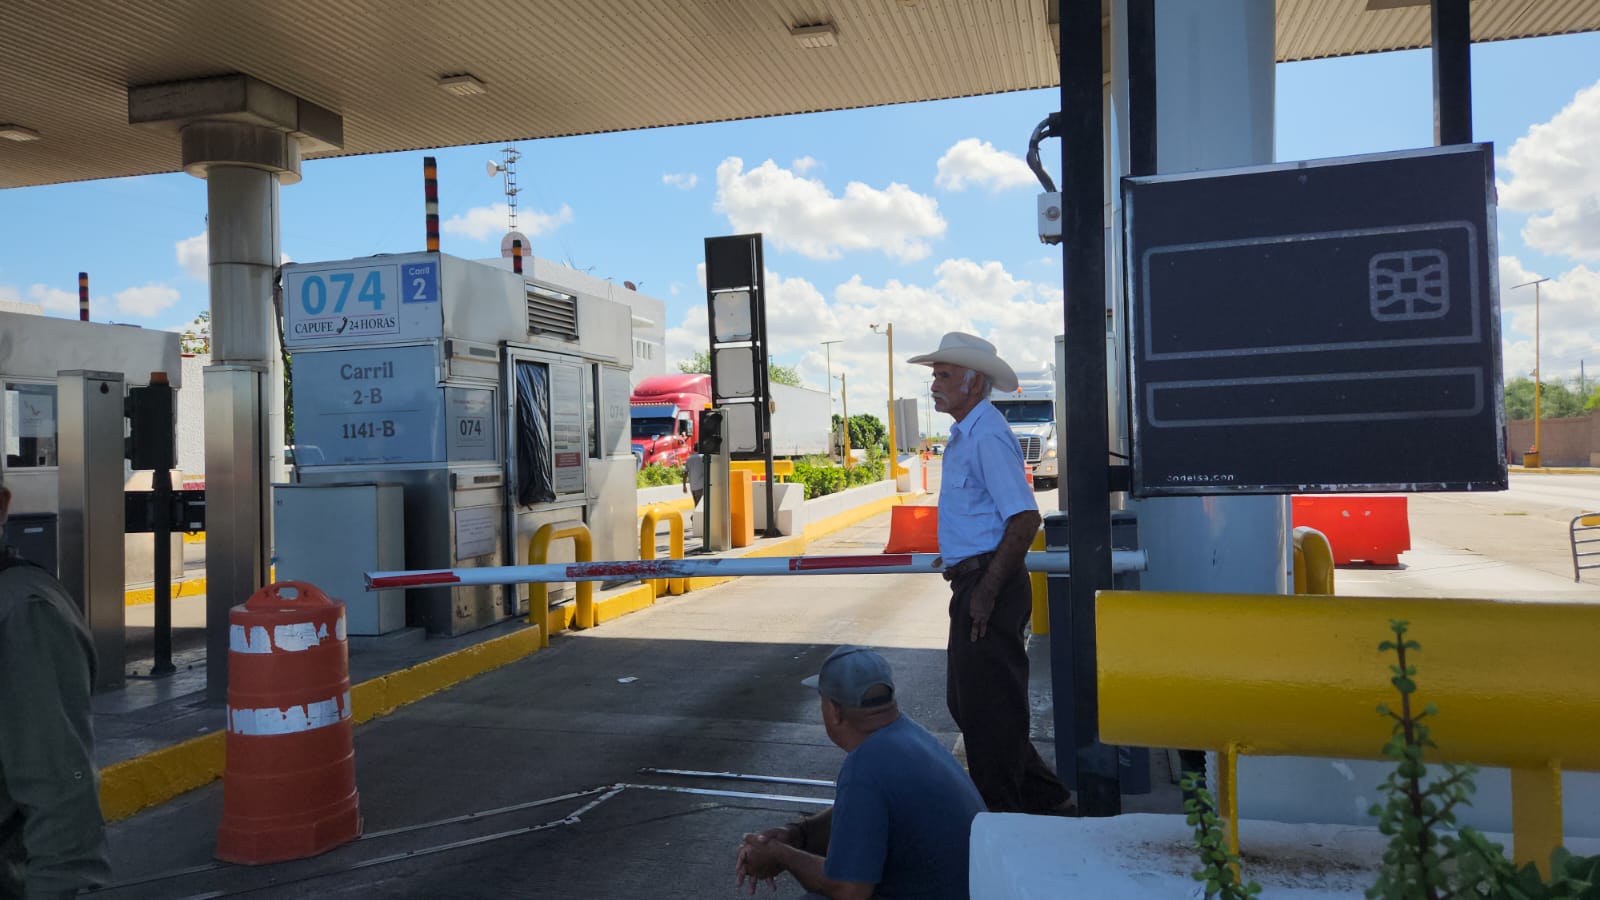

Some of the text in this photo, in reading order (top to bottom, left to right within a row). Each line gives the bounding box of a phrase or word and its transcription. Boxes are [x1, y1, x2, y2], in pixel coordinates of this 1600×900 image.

[408, 266, 430, 276] Carril
[301, 271, 386, 315] 074
[412, 277, 427, 300] 2
[294, 317, 396, 335] CAPUFE 24 HORAS
[340, 361, 394, 380] Carril
[353, 387, 383, 405] 2-B
[342, 420, 396, 439] 1141-B
[460, 419, 482, 437] 074
